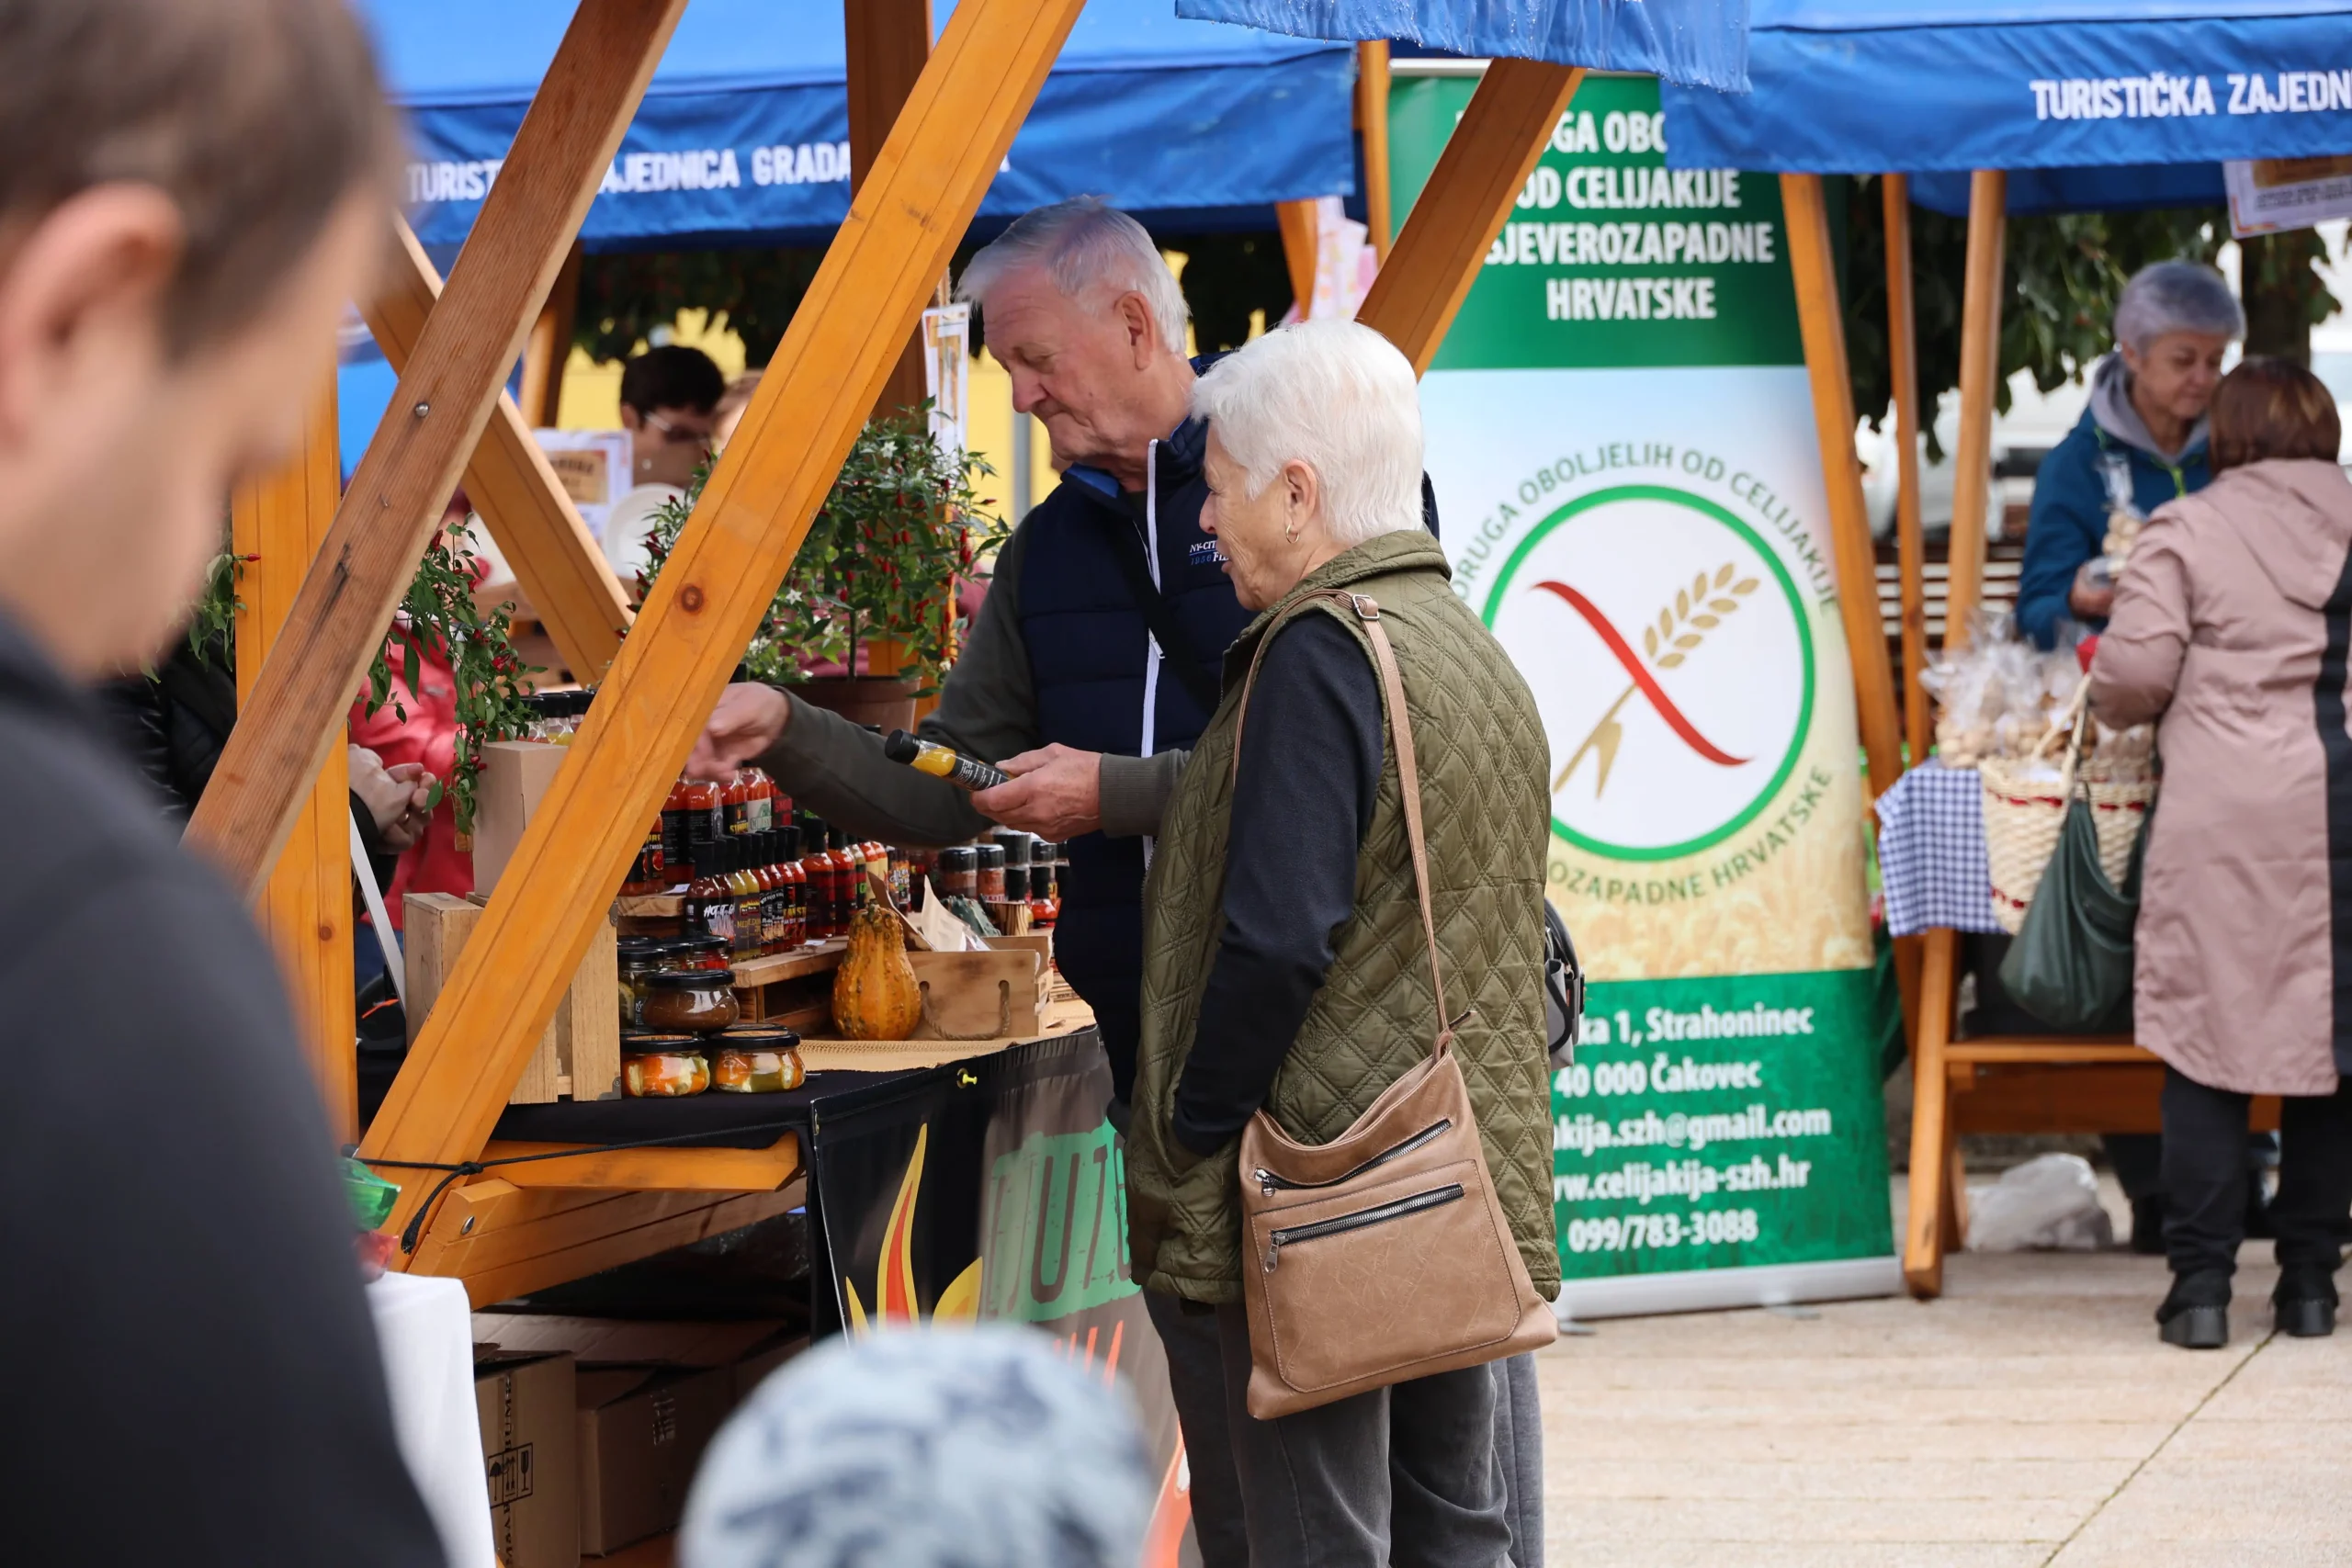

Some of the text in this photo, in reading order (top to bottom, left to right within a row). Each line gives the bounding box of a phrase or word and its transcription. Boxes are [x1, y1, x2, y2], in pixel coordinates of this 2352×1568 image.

[2028, 68, 2352, 121] TURISTIČKA ZAJEDN
[406, 159, 505, 202] TURIST
[597, 147, 741, 195] AJEDNICA
[1565, 166, 1743, 209] CELIJAKIJE
[1545, 277, 1717, 321] HRVATSKE
[1452, 502, 1520, 601] DRUGA
[1518, 442, 1674, 505] OBOLJELIH
[1681, 449, 1725, 482] OD
[1190, 540, 1216, 553] NY-CIT
[1547, 764, 1834, 906] OZAPADNE HRVATSKE
[1577, 1002, 1815, 1048] ka 1, Strahoninec
[1593, 1059, 1648, 1097] 000
[1650, 1052, 1762, 1093] Čakovec
[1553, 1103, 1833, 1157] kija.szh@gmail.com
[1554, 1153, 1811, 1206] w.celijakija-szh.hr
[1567, 1209, 1760, 1254] 099/783-3088
